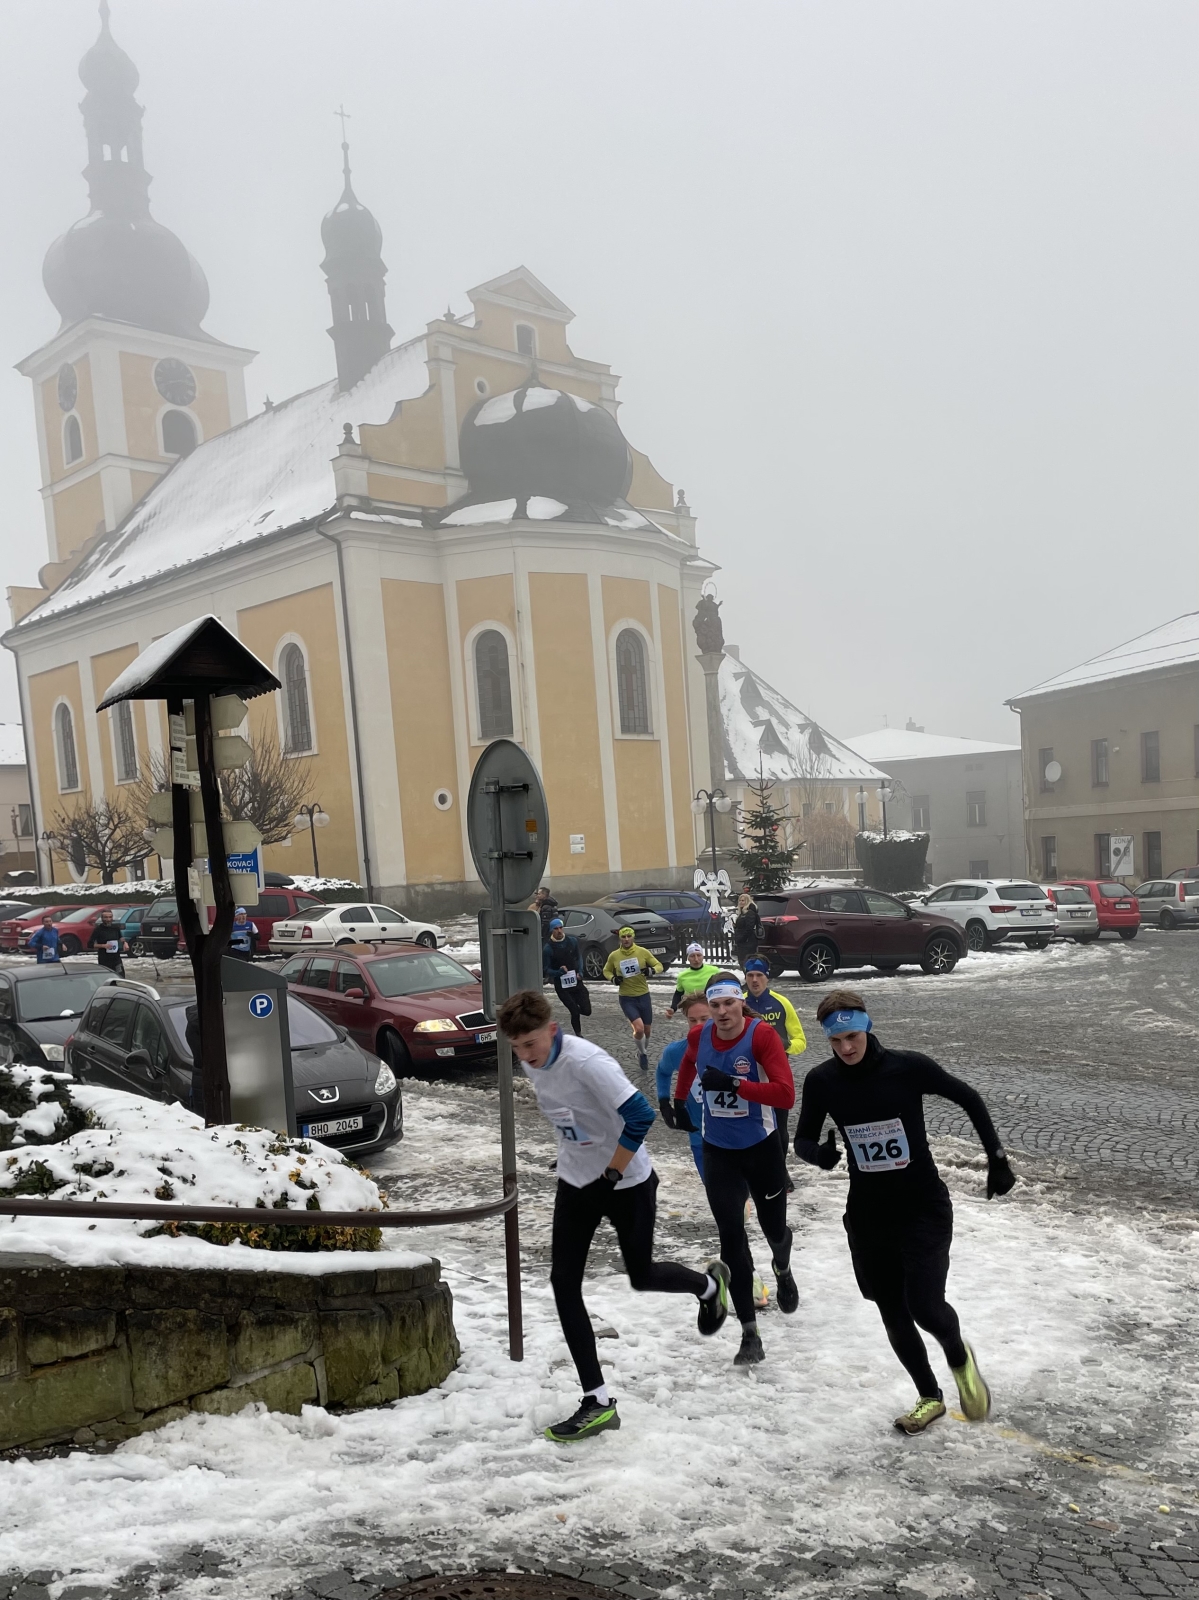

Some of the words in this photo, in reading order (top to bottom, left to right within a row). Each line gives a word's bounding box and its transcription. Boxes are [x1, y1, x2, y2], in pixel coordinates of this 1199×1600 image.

[227, 859, 254, 868] KOVACÍ
[625, 965, 636, 974] 25
[563, 976, 576, 985] 118
[256, 998, 268, 1014] P
[714, 1092, 738, 1109] 42
[336, 1118, 359, 1132] 2045
[858, 1138, 903, 1162] 126
